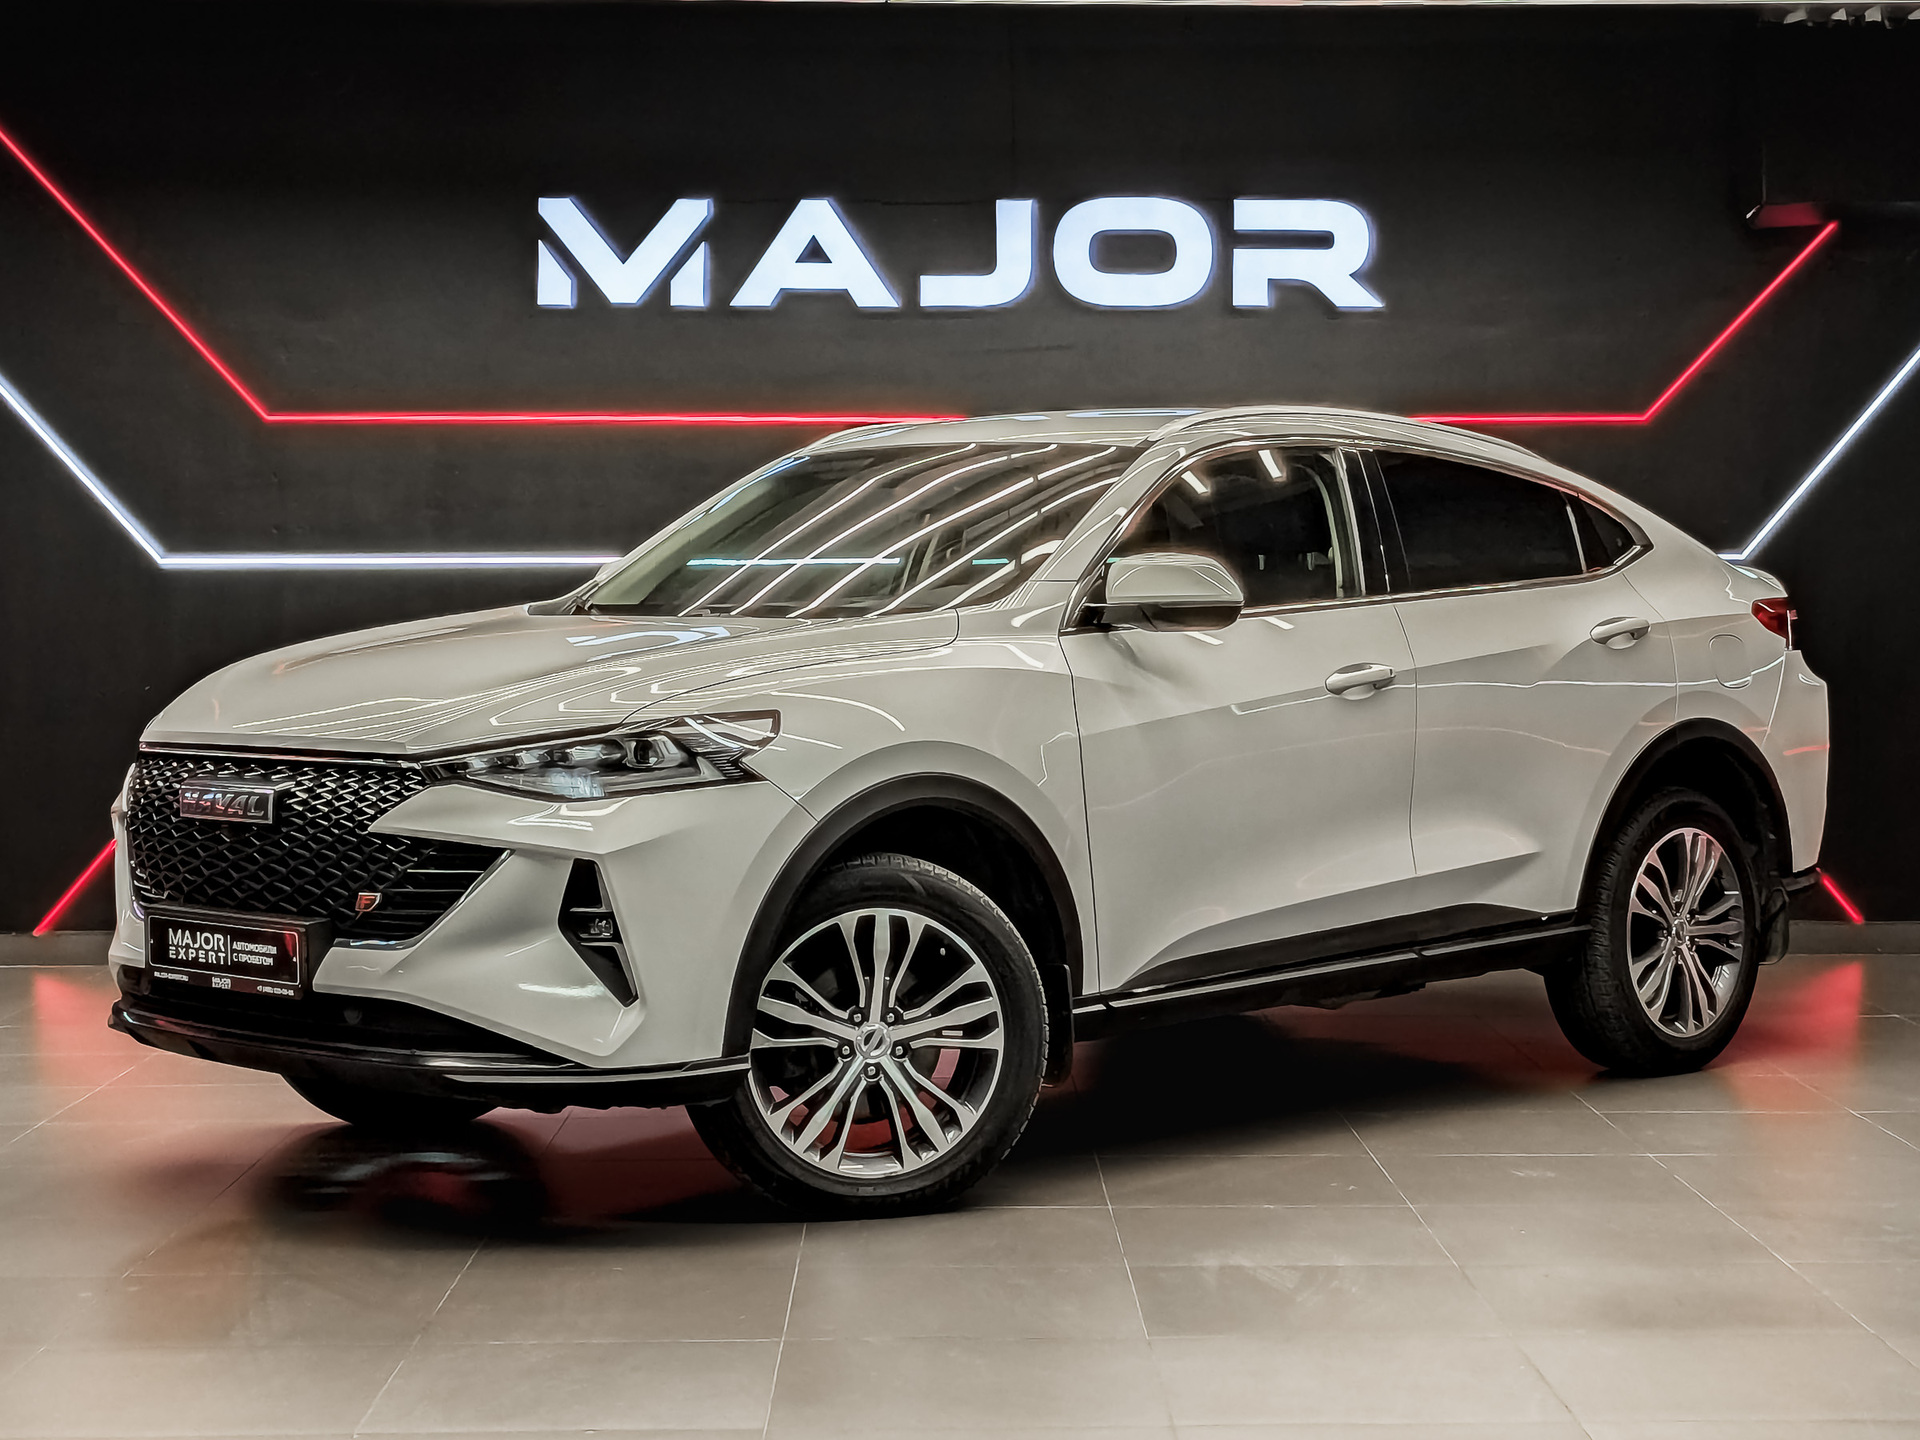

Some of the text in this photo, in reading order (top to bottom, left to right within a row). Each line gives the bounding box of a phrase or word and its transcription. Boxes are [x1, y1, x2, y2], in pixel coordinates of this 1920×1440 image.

[538, 196, 1384, 308] MAJOR
[168, 928, 225, 952] MAJOR
[169, 946, 226, 965] EXPERT
